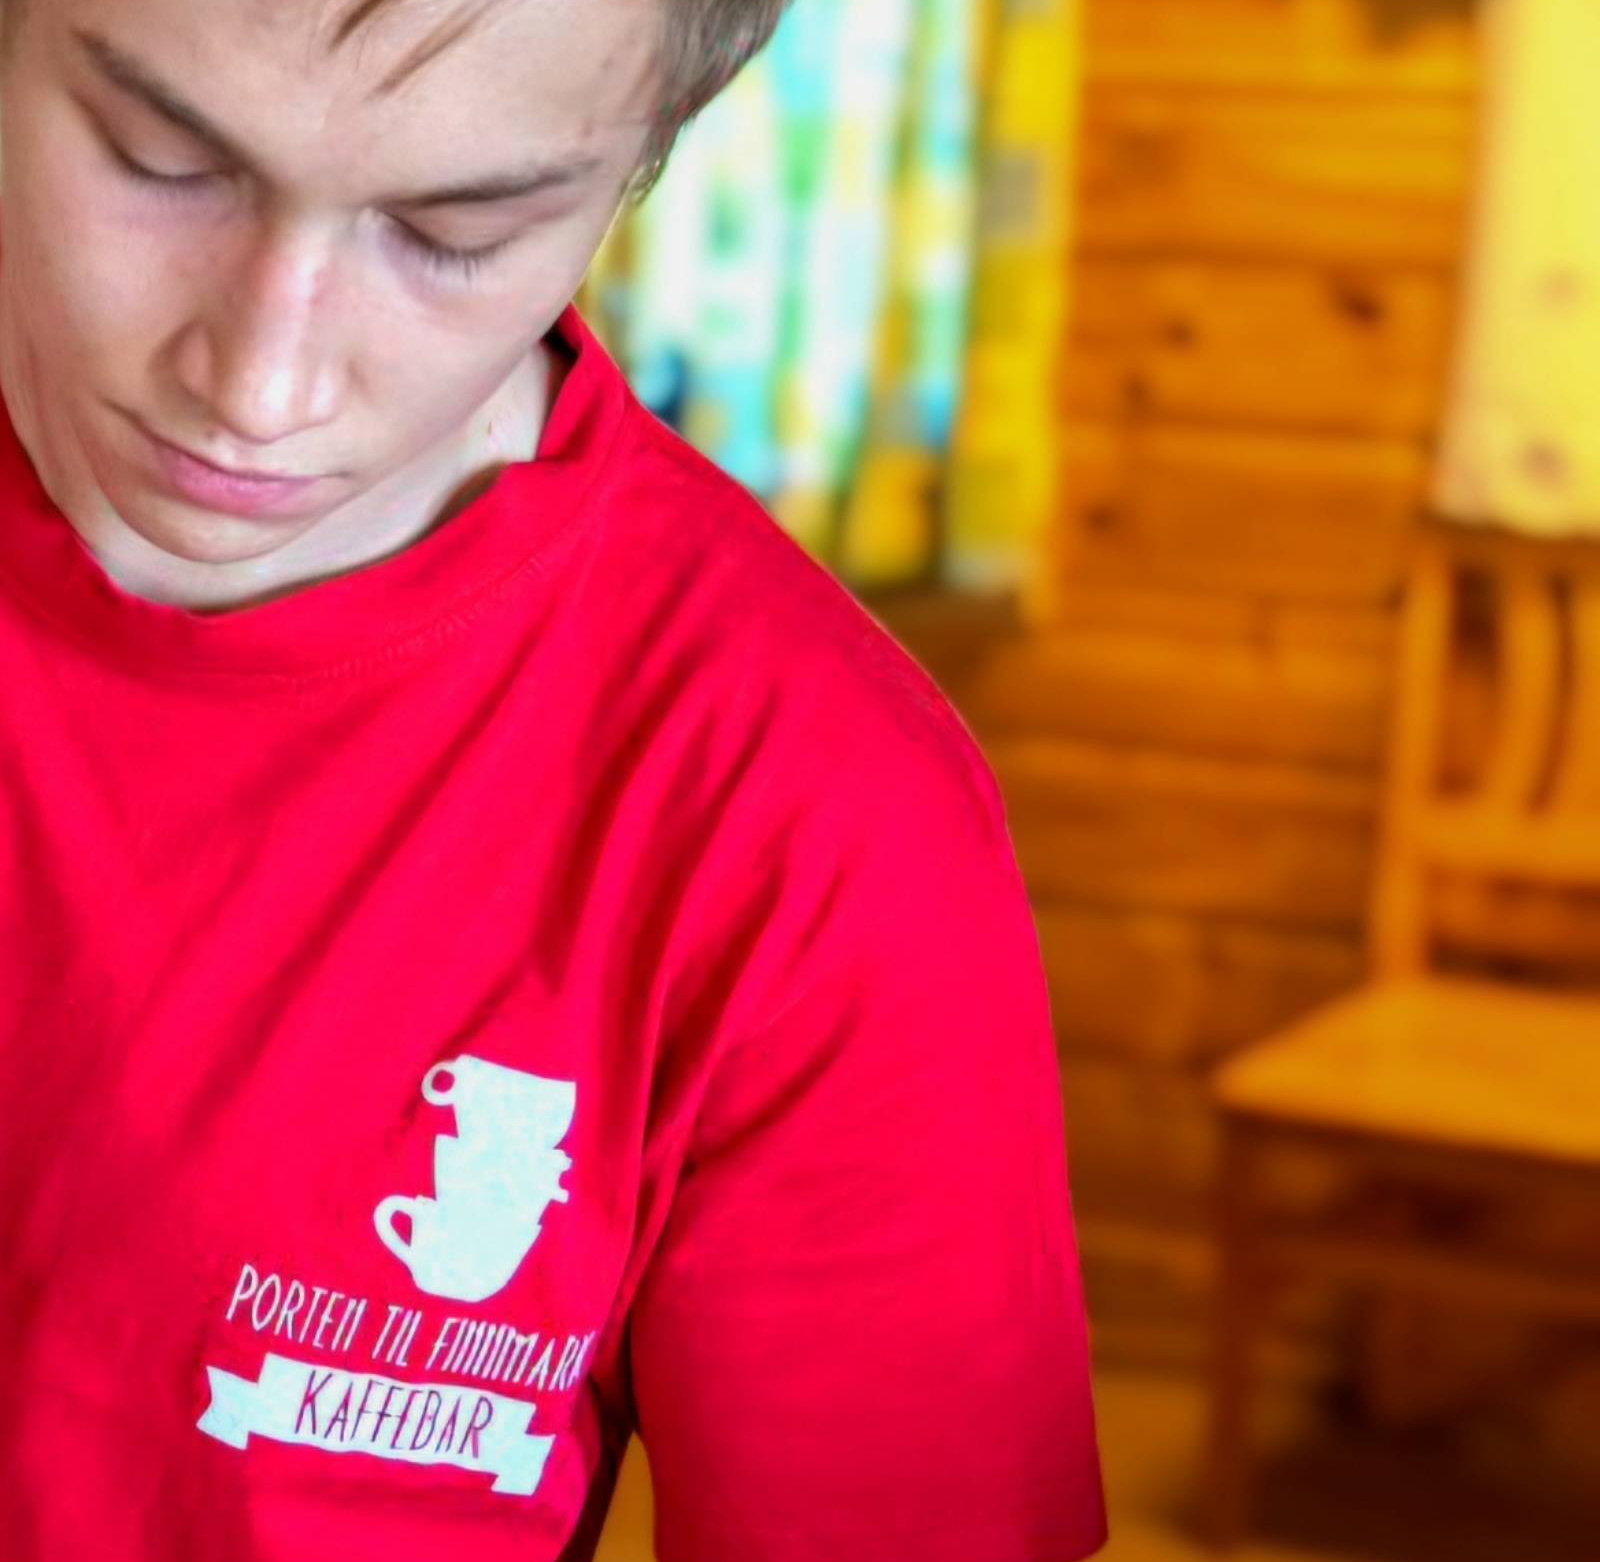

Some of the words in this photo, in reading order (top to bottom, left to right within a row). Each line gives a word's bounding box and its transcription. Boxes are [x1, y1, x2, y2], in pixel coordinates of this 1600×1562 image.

[225, 1263, 367, 1352] PORTEN
[372, 1304, 422, 1368] TIL
[294, 1369, 494, 1459] KAFFEBAR
